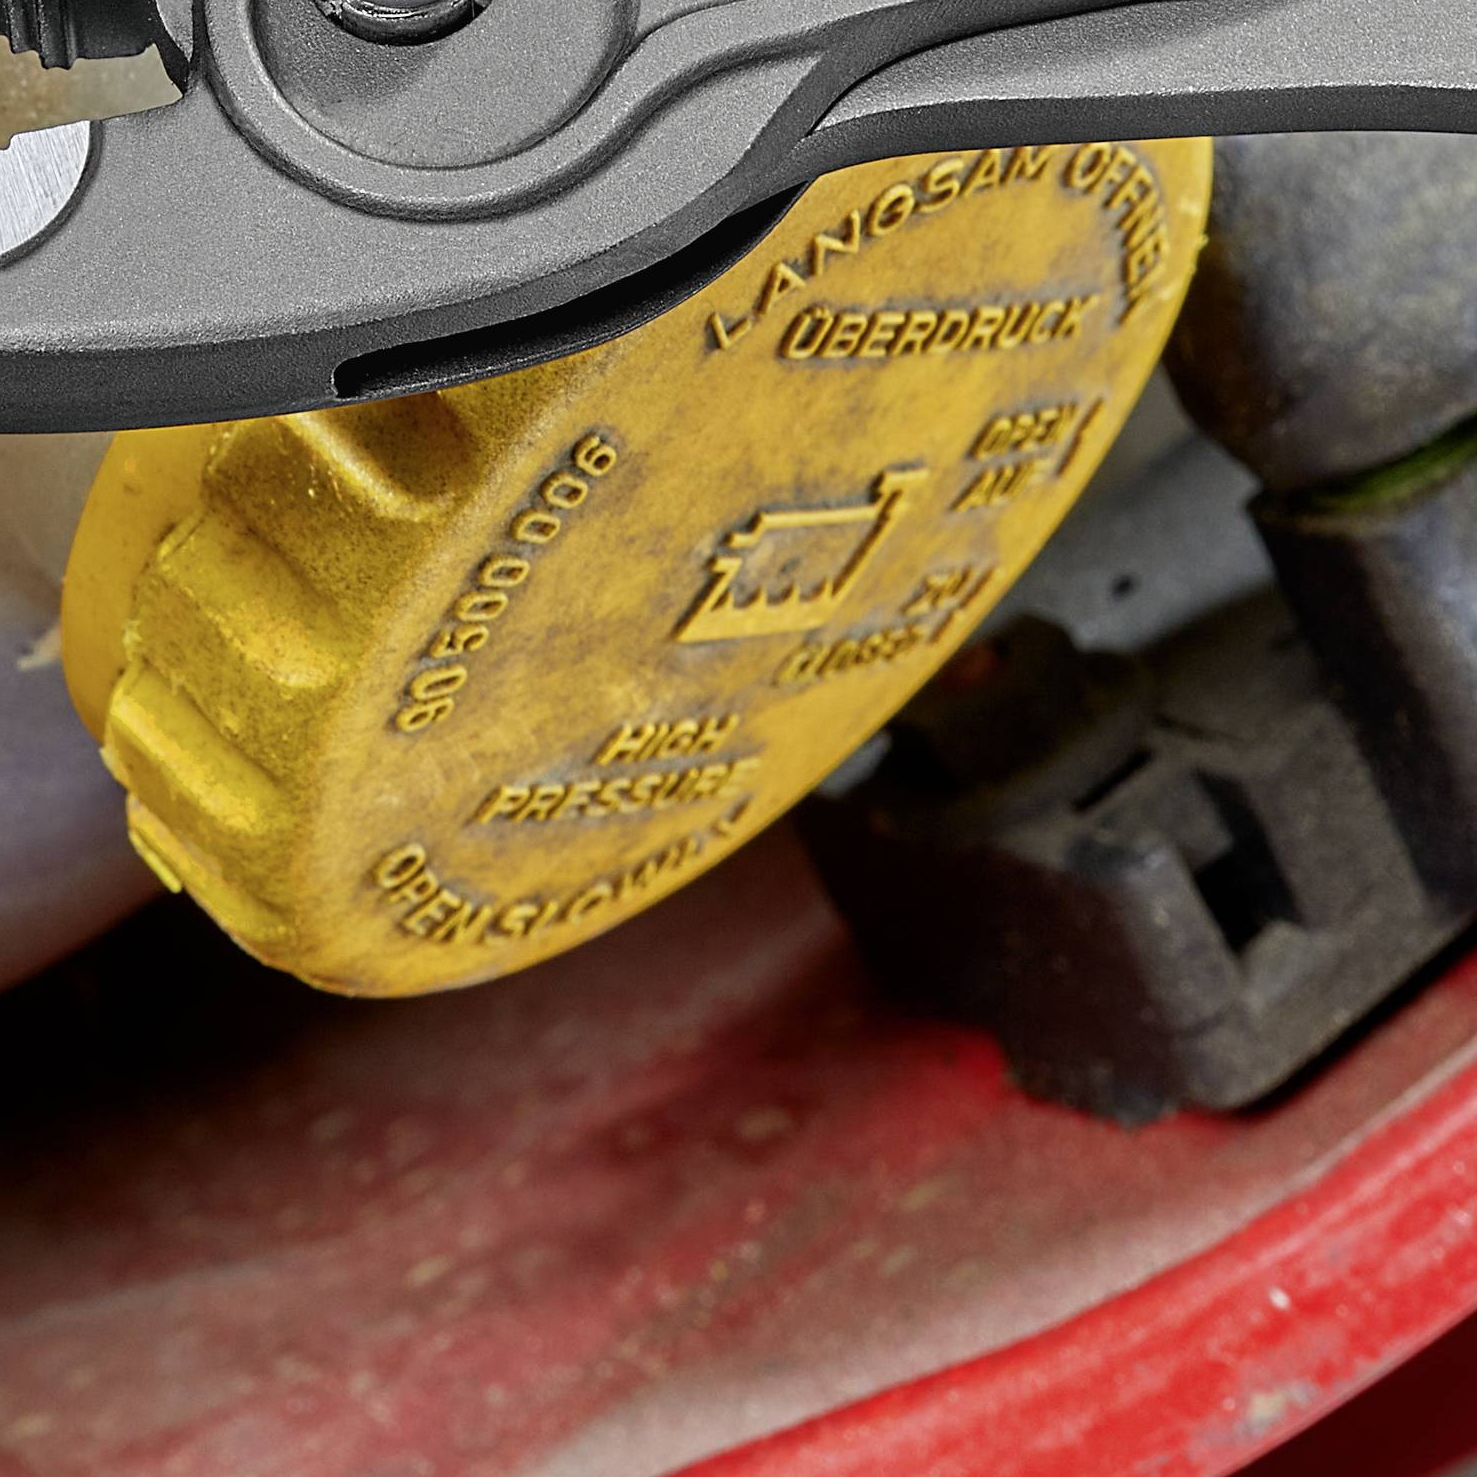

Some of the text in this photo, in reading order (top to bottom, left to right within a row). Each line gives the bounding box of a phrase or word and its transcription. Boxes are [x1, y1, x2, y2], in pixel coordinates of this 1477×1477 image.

[708, 146, 1052, 350] LANGSAM
[779, 294, 1101, 360] ÜBERDRUCK
[591, 714, 739, 766] HIGH
[474, 757, 762, 825] PRESSURE
[375, 842, 493, 944] OPEN
